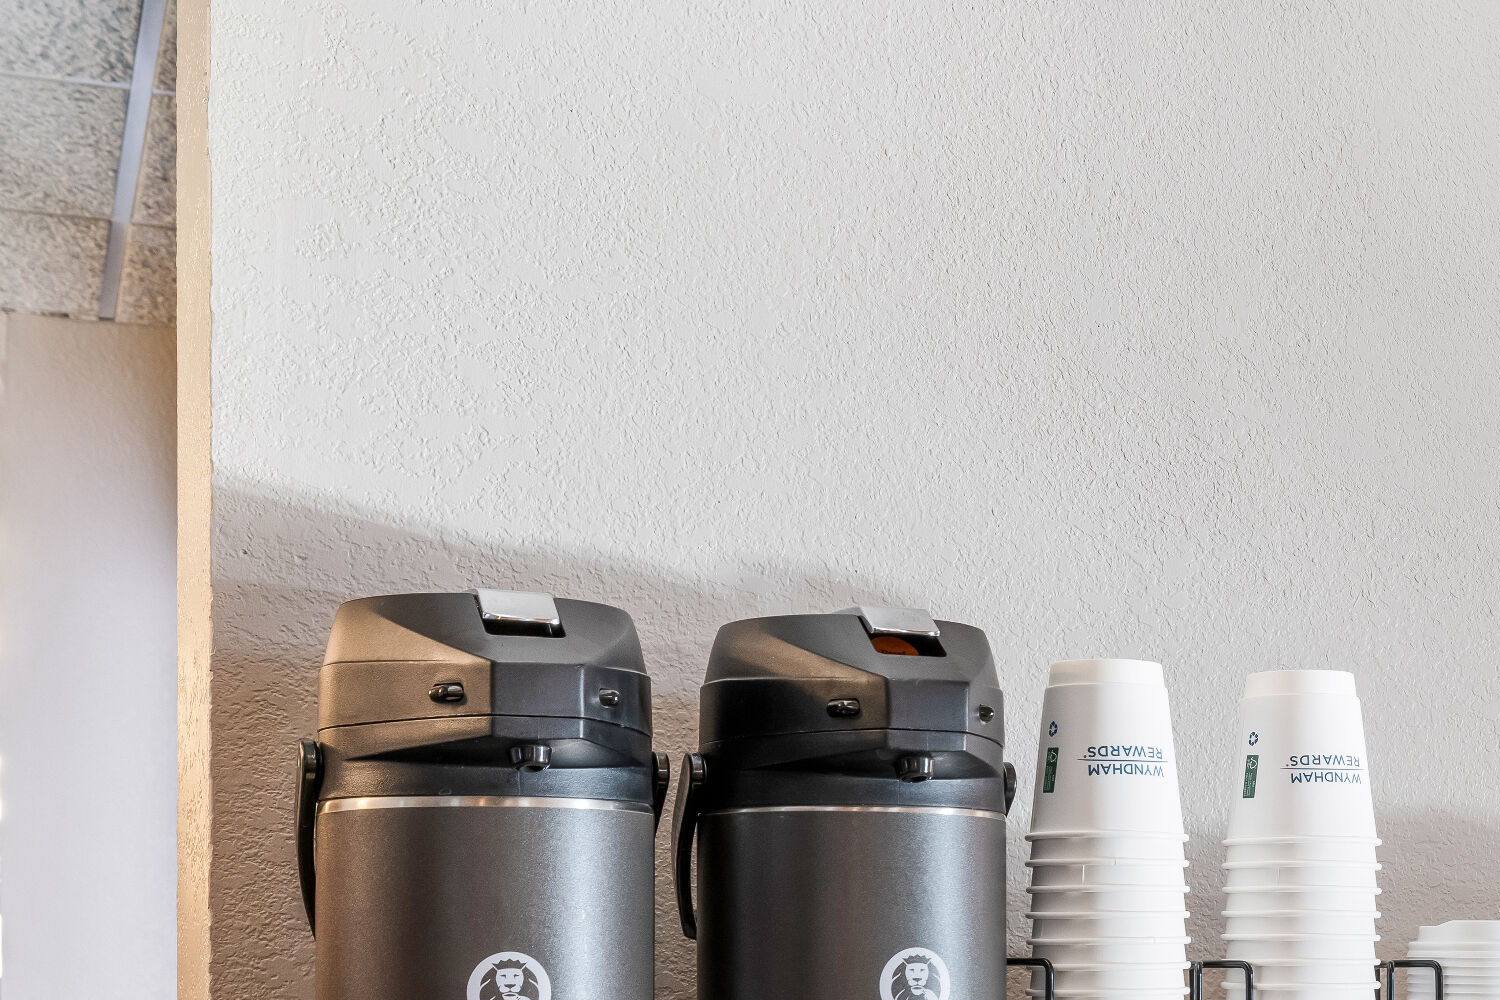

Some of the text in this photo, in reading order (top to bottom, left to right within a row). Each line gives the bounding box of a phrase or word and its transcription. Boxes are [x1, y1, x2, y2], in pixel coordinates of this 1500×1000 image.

[1087, 745, 1163, 759] REWARDS
[1289, 754, 1360, 767] REWARDS
[1087, 764, 1164, 777] WYNDHAM
[1290, 772, 1361, 784] WYNDHAM
